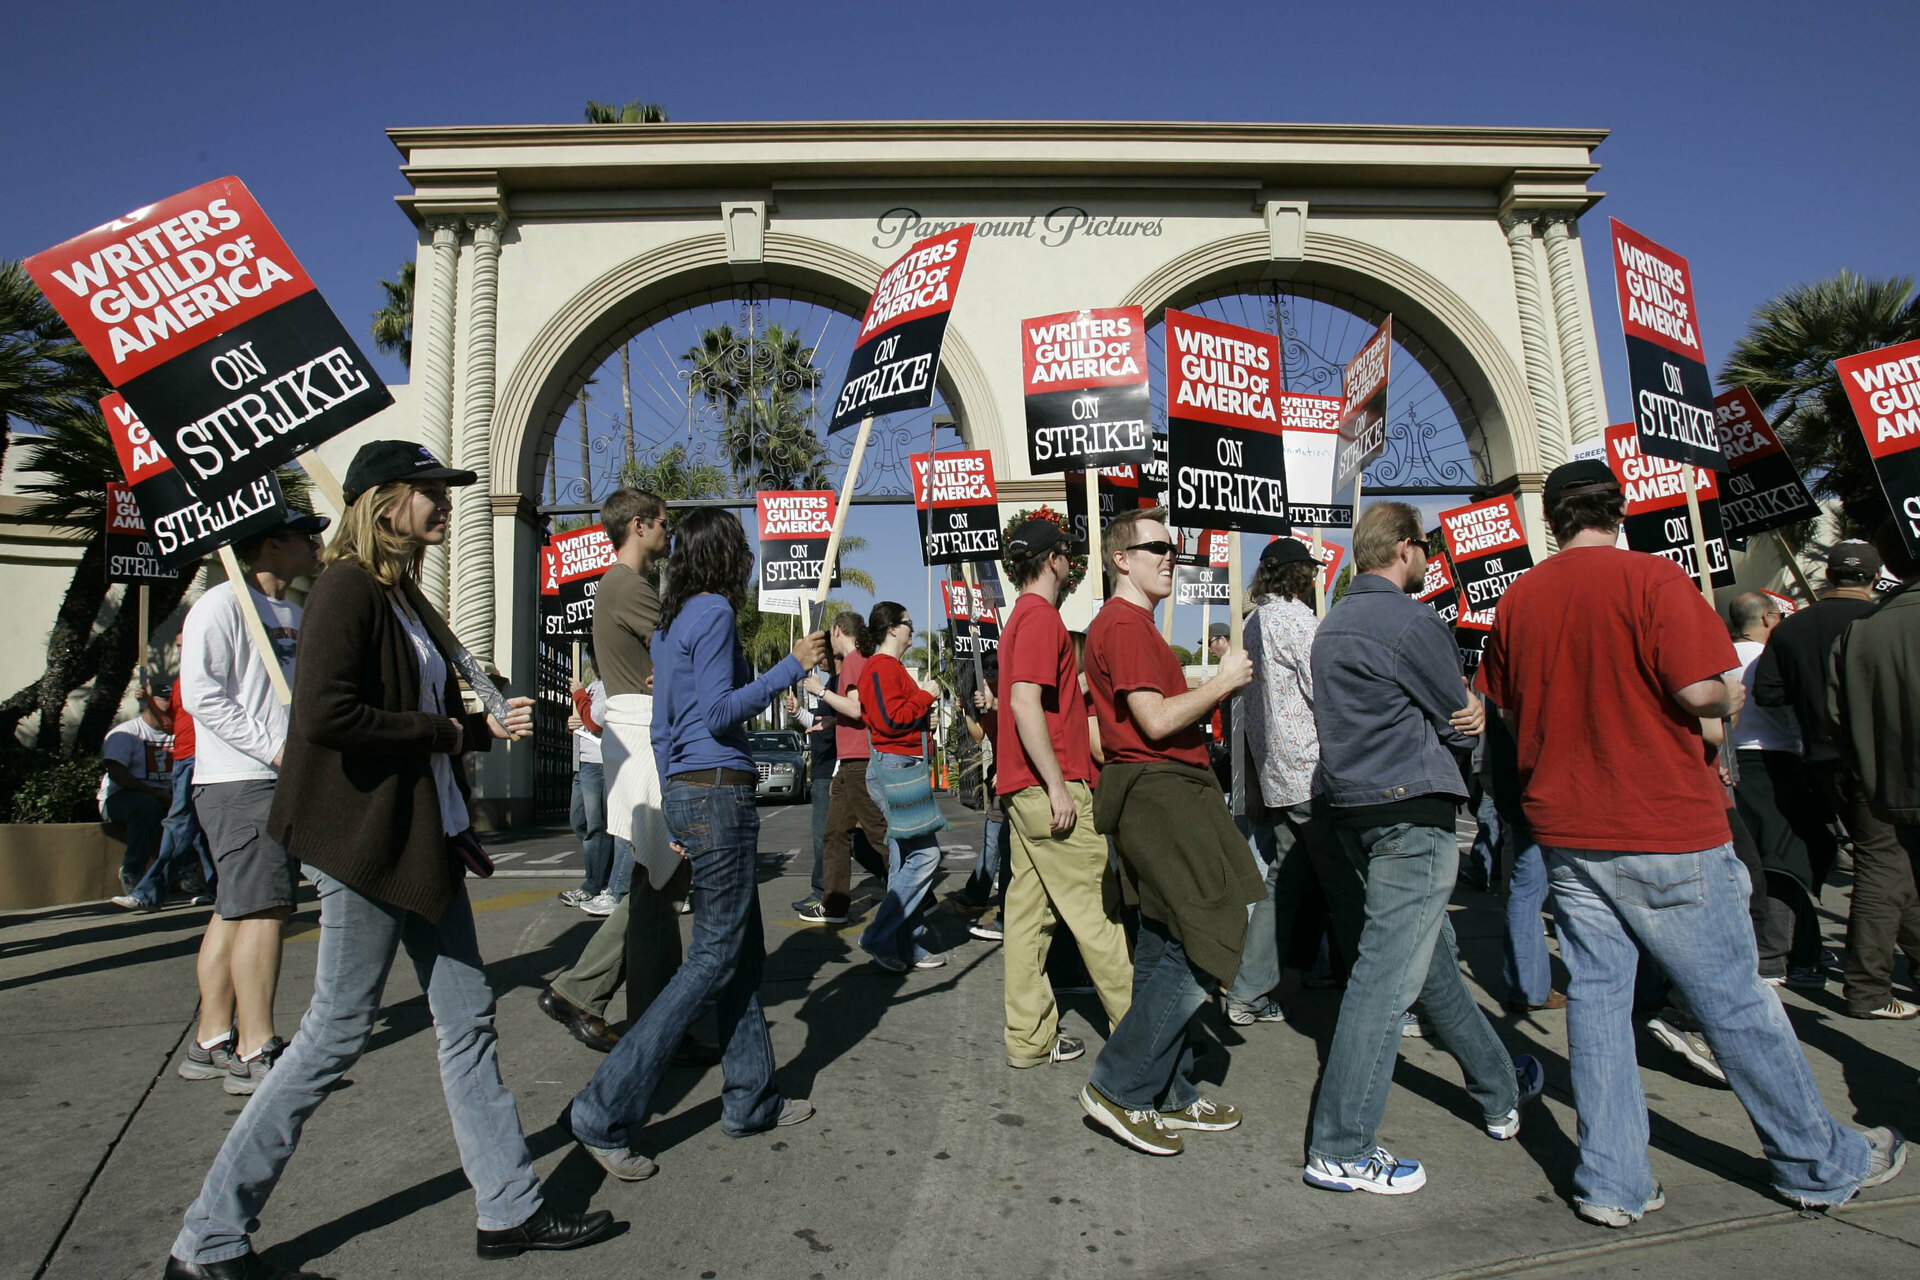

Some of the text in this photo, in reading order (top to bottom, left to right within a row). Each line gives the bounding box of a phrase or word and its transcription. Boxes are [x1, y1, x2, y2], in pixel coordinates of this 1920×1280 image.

[872, 206, 1163, 249] Paraount Pictures
[51, 198, 241, 298] WRITERS
[90, 234, 256, 324] GUILD OF
[878, 238, 959, 293] WRITERS
[1617, 237, 1685, 295] WRITERS
[873, 265, 950, 311] GUILD OF
[1626, 269, 1688, 320] GUILD OF
[106, 256, 294, 364] AMERICA
[861, 282, 949, 337] AMERICA
[1628, 297, 1698, 350] AMERICA
[1029, 318, 1132, 345] WRITERS
[874, 335, 901, 365] ON
[1035, 339, 1130, 364] GUILD OF
[1174, 326, 1270, 371] WRITERS
[1346, 330, 1386, 381] WRITERS
[211, 341, 267, 391] ON
[1031, 356, 1140, 384] AMERICA
[1181, 354, 1269, 395] GUILD OF
[1346, 352, 1385, 398] GUILD OF
[1662, 361, 1683, 396] ON
[836, 352, 932, 418] STRIKE
[1342, 368, 1385, 418] AMERICA
[176, 346, 370, 481] STRIKE
[1072, 398, 1099, 421] ON
[1176, 380, 1277, 422] AMERICA
[1323, 411, 1338, 420] OF
[1354, 410, 1367, 436] ON
[1639, 389, 1720, 453] STRIKE
[1732, 420, 1753, 437] OF
[1035, 420, 1146, 461] STRIKE
[1217, 437, 1243, 468] ON
[1339, 417, 1383, 480] STRIKE
[970, 474, 985, 485] OF
[1178, 466, 1284, 518] STRIKE
[1625, 469, 1712, 502] AMERIA
[1728, 473, 1755, 495] ON
[763, 497, 828, 510] WRITERS
[767, 510, 828, 522] GUILD OF
[1288, 507, 1351, 525] TRIKE
[1445, 502, 1510, 530] WRITERS
[764, 521, 833, 534] AMERICA
[950, 513, 968, 529] ON
[1453, 518, 1511, 543] GUILD OF
[1664, 516, 1690, 543] ON
[561, 545, 599, 564] GUILD
[600, 543, 614, 554] OF
[790, 544, 808, 558] ON
[926, 529, 999, 556] STRIKE
[1455, 529, 1520, 556] AMERICA
[111, 555, 178, 578] STRI
[561, 552, 618, 578] AMERICA
[1200, 571, 1213, 582] ON
[1433, 571, 1443, 580] OF
[1485, 557, 1504, 575] ON
[1467, 567, 1531, 604] STRI
